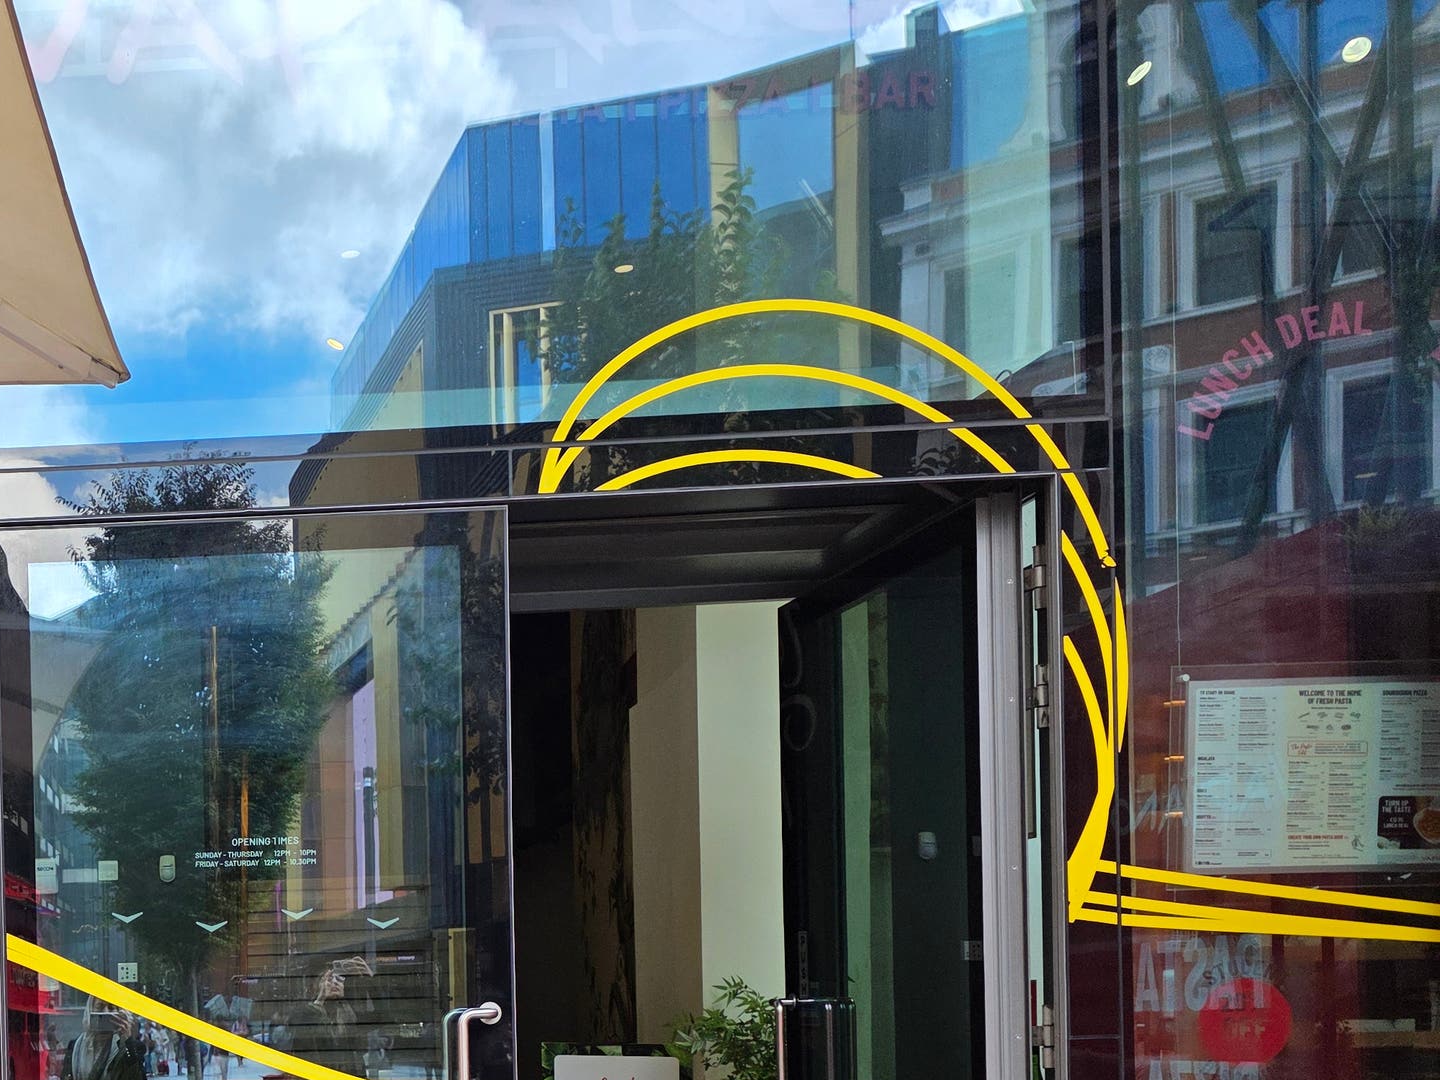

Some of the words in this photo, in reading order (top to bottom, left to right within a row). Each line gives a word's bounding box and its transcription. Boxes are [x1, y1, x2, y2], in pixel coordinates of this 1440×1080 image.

[1177, 331, 1274, 440] LUNCH
[1275, 301, 1372, 350] DEAL
[231, 838, 270, 847] OPENING
[272, 837, 300, 845] TIMES
